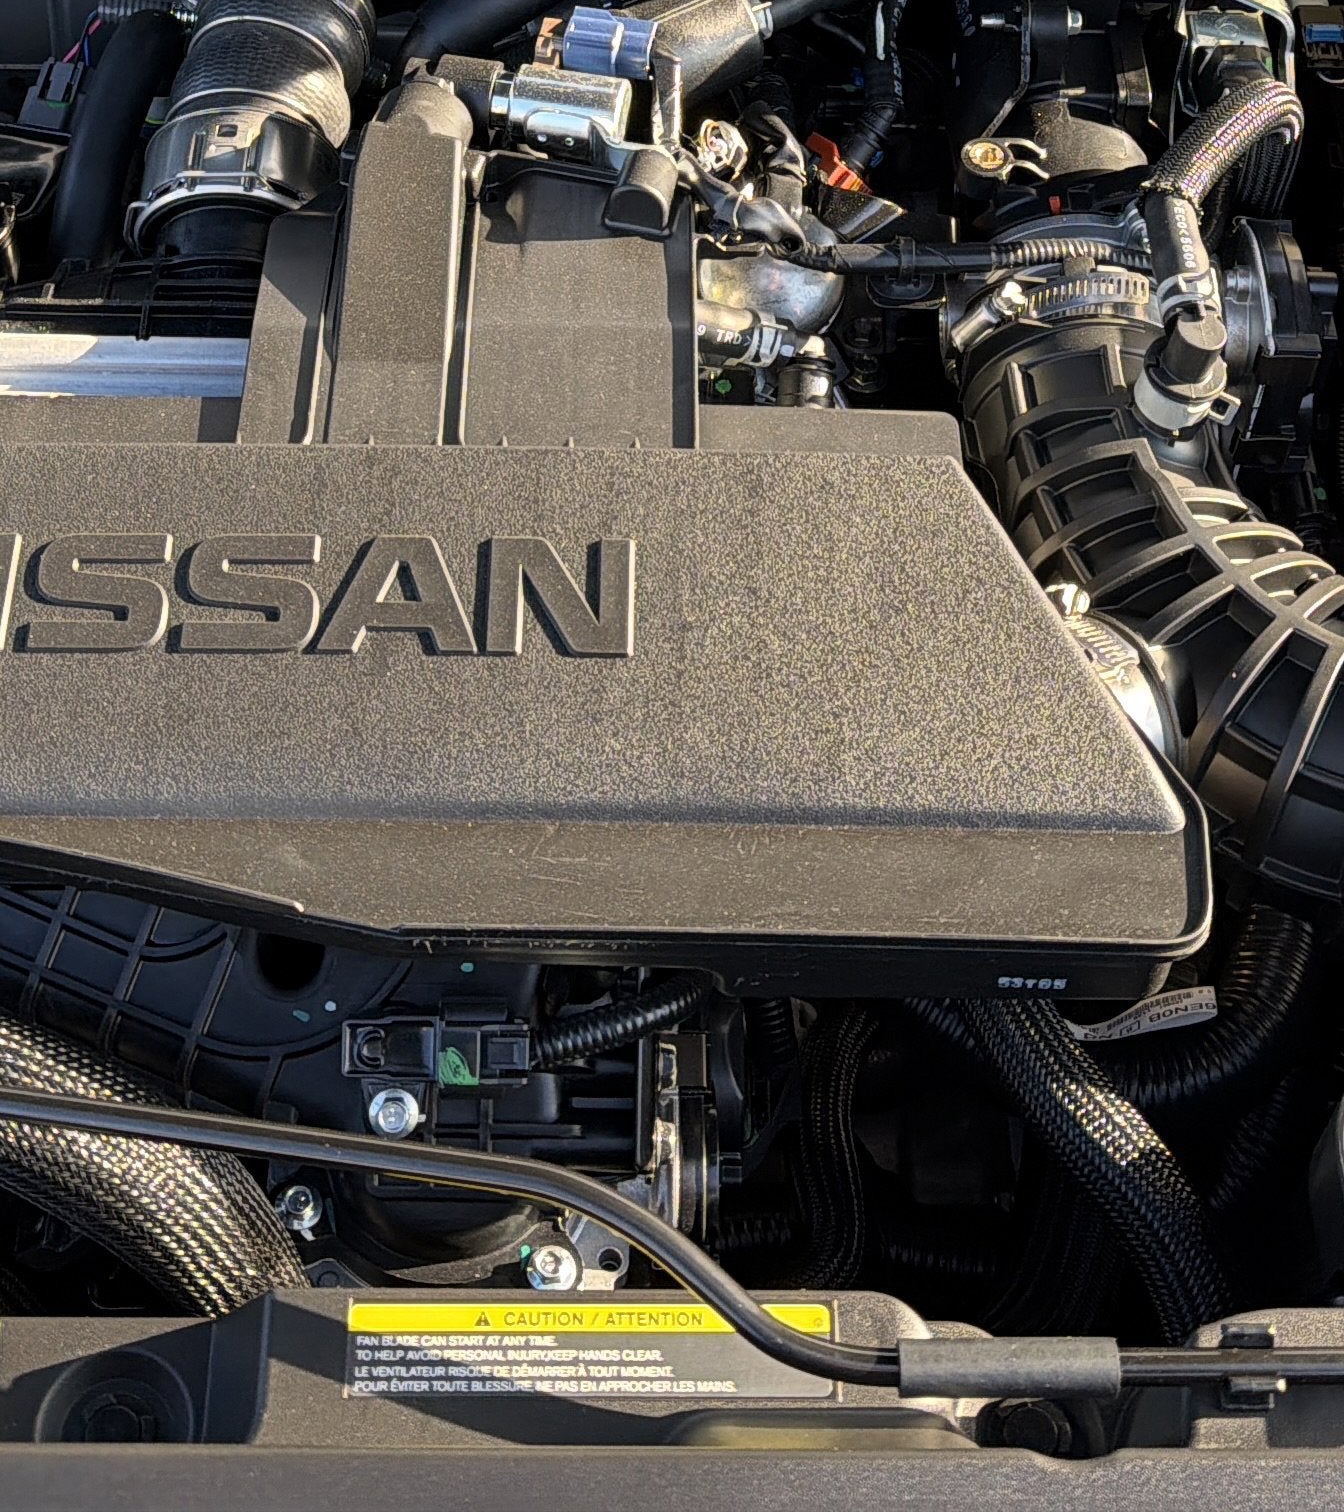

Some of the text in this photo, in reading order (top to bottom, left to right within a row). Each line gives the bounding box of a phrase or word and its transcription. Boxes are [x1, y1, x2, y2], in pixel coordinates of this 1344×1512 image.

[504, 1311, 584, 1327] CAUTION
[605, 1311, 703, 1327] ATTENTION
[356, 1335, 559, 1346] FAN BLADE CAN START AT ANY TIME.
[355, 1350, 372, 1361] TO
[374, 1350, 405, 1361] HELP
[407, 1350, 441, 1361] AVOID
[443, 1350, 506, 1361] PERSONAL
[578, 1350, 621, 1361] HANDS
[622, 1350, 664, 1361] CLEAR.
[354, 1363, 675, 1377] LE VENTILATEUR RISQUE DE DÉMARRER À TOUT MOMENT.
[353, 1381, 389, 1392] POUR
[390, 1378, 429, 1392] ÉVITER
[431, 1381, 469, 1392] TOUTE
[535, 1381, 554, 1392] NE
[554, 1381, 579, 1392] PAS
[580, 1381, 598, 1392] EN
[598, 1381, 674, 1392] APPROCHER
[673, 1381, 696, 1392] LES
[696, 1381, 737, 1392] MAINS.
